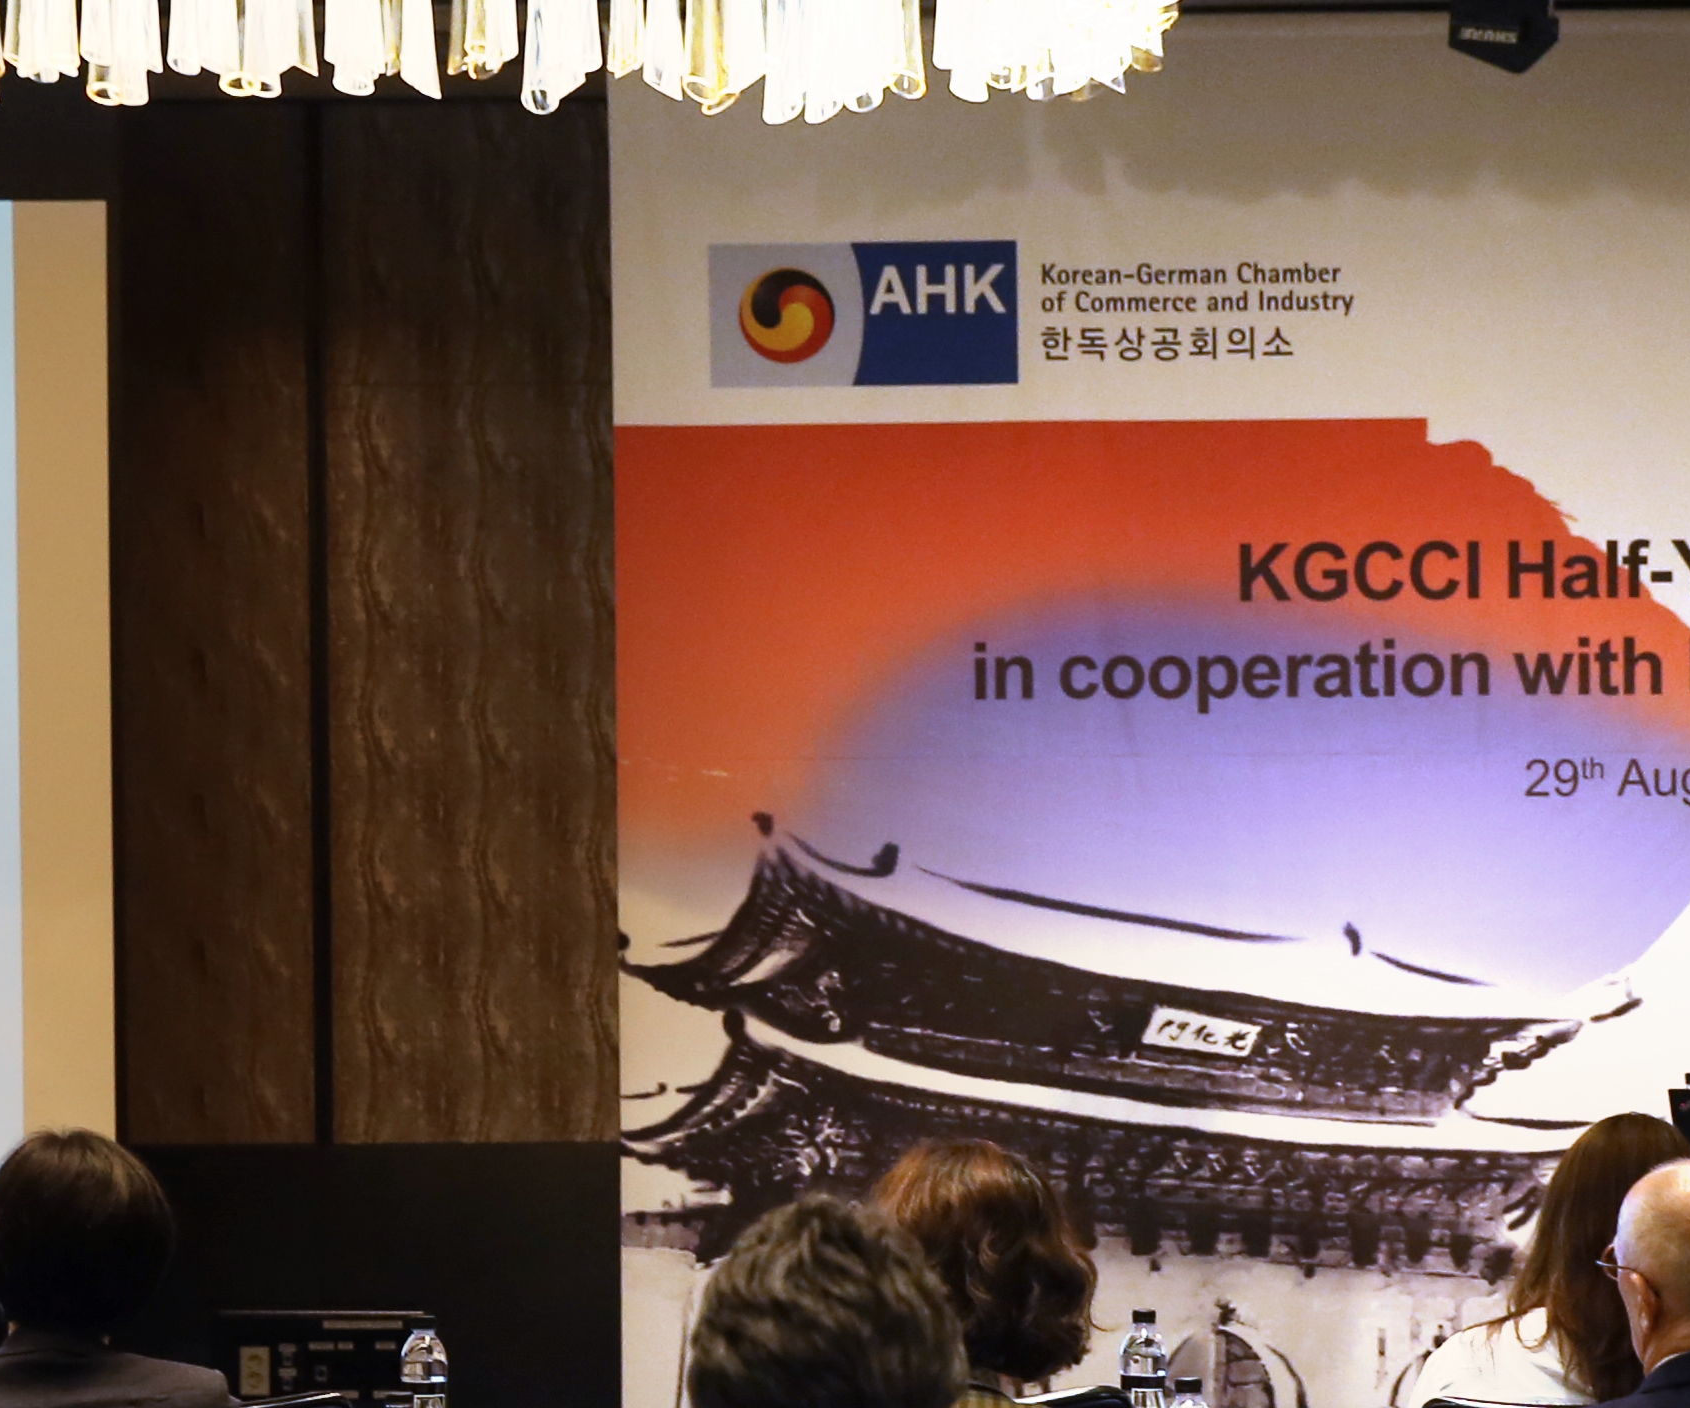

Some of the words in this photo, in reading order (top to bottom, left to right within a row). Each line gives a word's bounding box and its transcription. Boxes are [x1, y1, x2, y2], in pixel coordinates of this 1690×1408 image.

[870, 264, 1006, 315] AHK
[1041, 263, 1227, 285] Korean-German
[1237, 262, 1341, 284] Chamber
[1041, 291, 1066, 312] of
[1075, 291, 1197, 313] Commerce
[1207, 291, 1248, 312] and
[1259, 291, 1354, 316] Industry
[1041, 326, 1293, 361] 한독상공회의소
[1239, 540, 1480, 602] KGCCI
[974, 642, 1034, 700] in
[1059, 638, 1490, 714] cooperation
[1512, 636, 1662, 696] with
